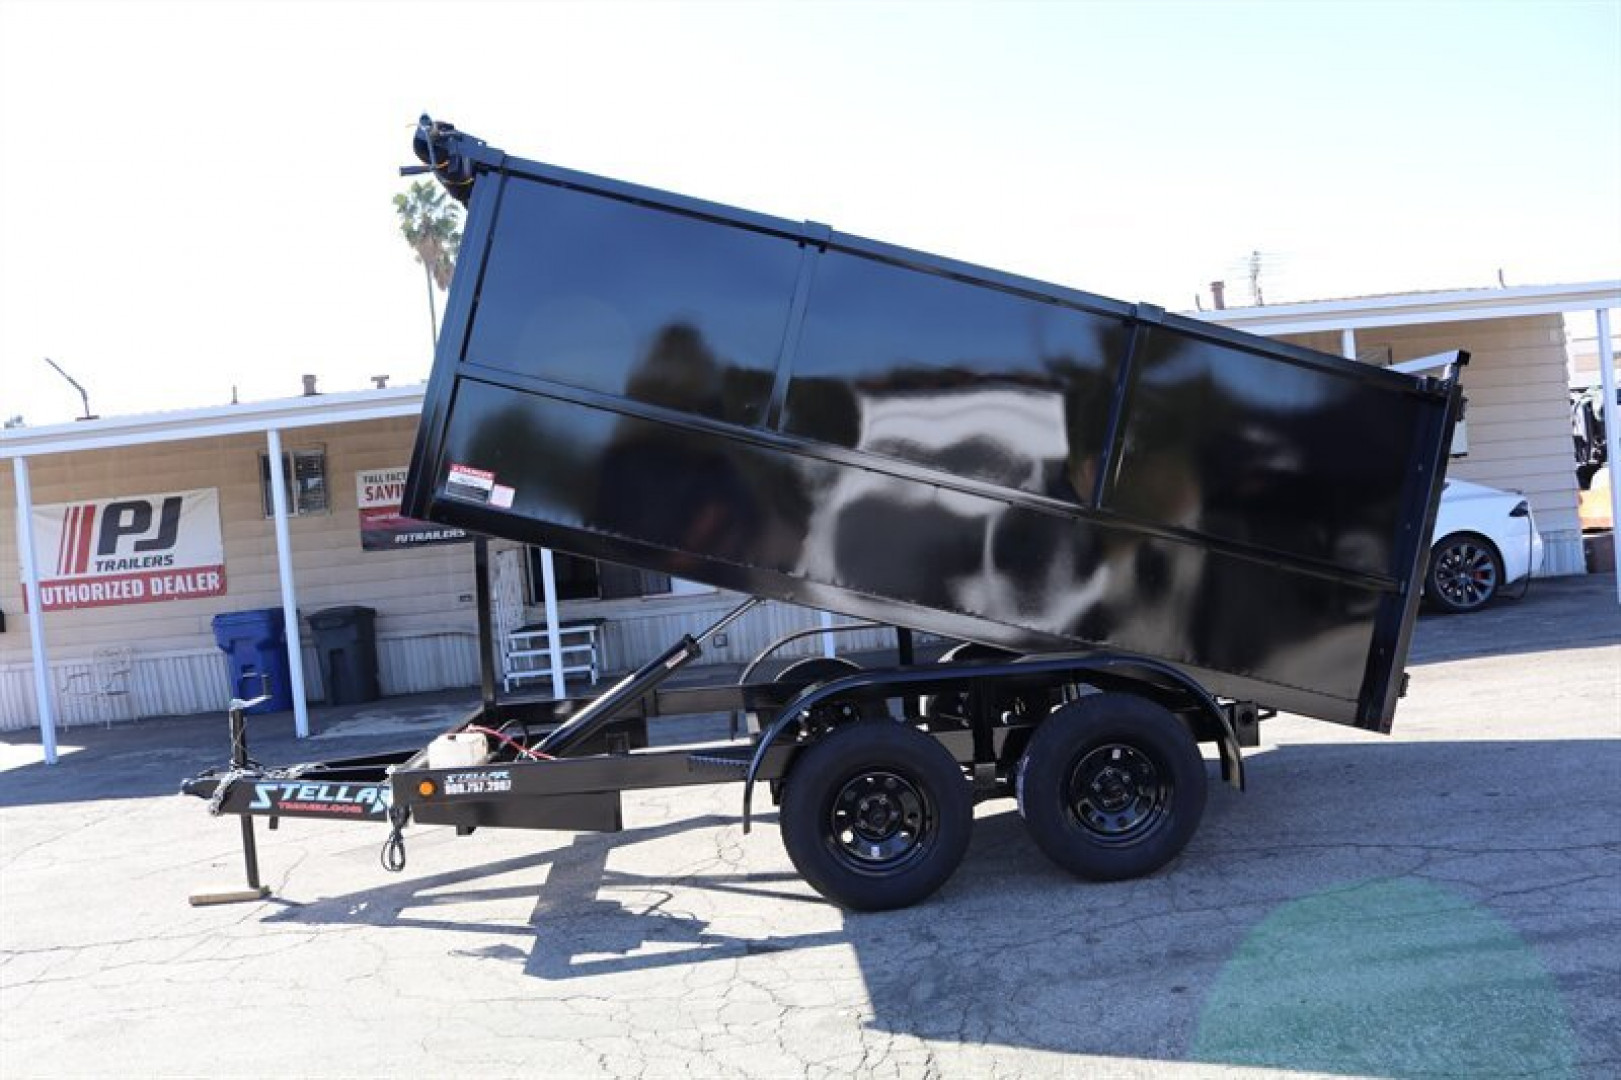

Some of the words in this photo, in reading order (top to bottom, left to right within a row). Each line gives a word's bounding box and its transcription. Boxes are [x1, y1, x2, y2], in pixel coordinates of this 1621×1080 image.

[97, 496, 183, 555] PJ
[95, 554, 174, 572] TRAILERS
[40, 577, 144, 605] UTHORIZED
[151, 571, 220, 596] DEALER
